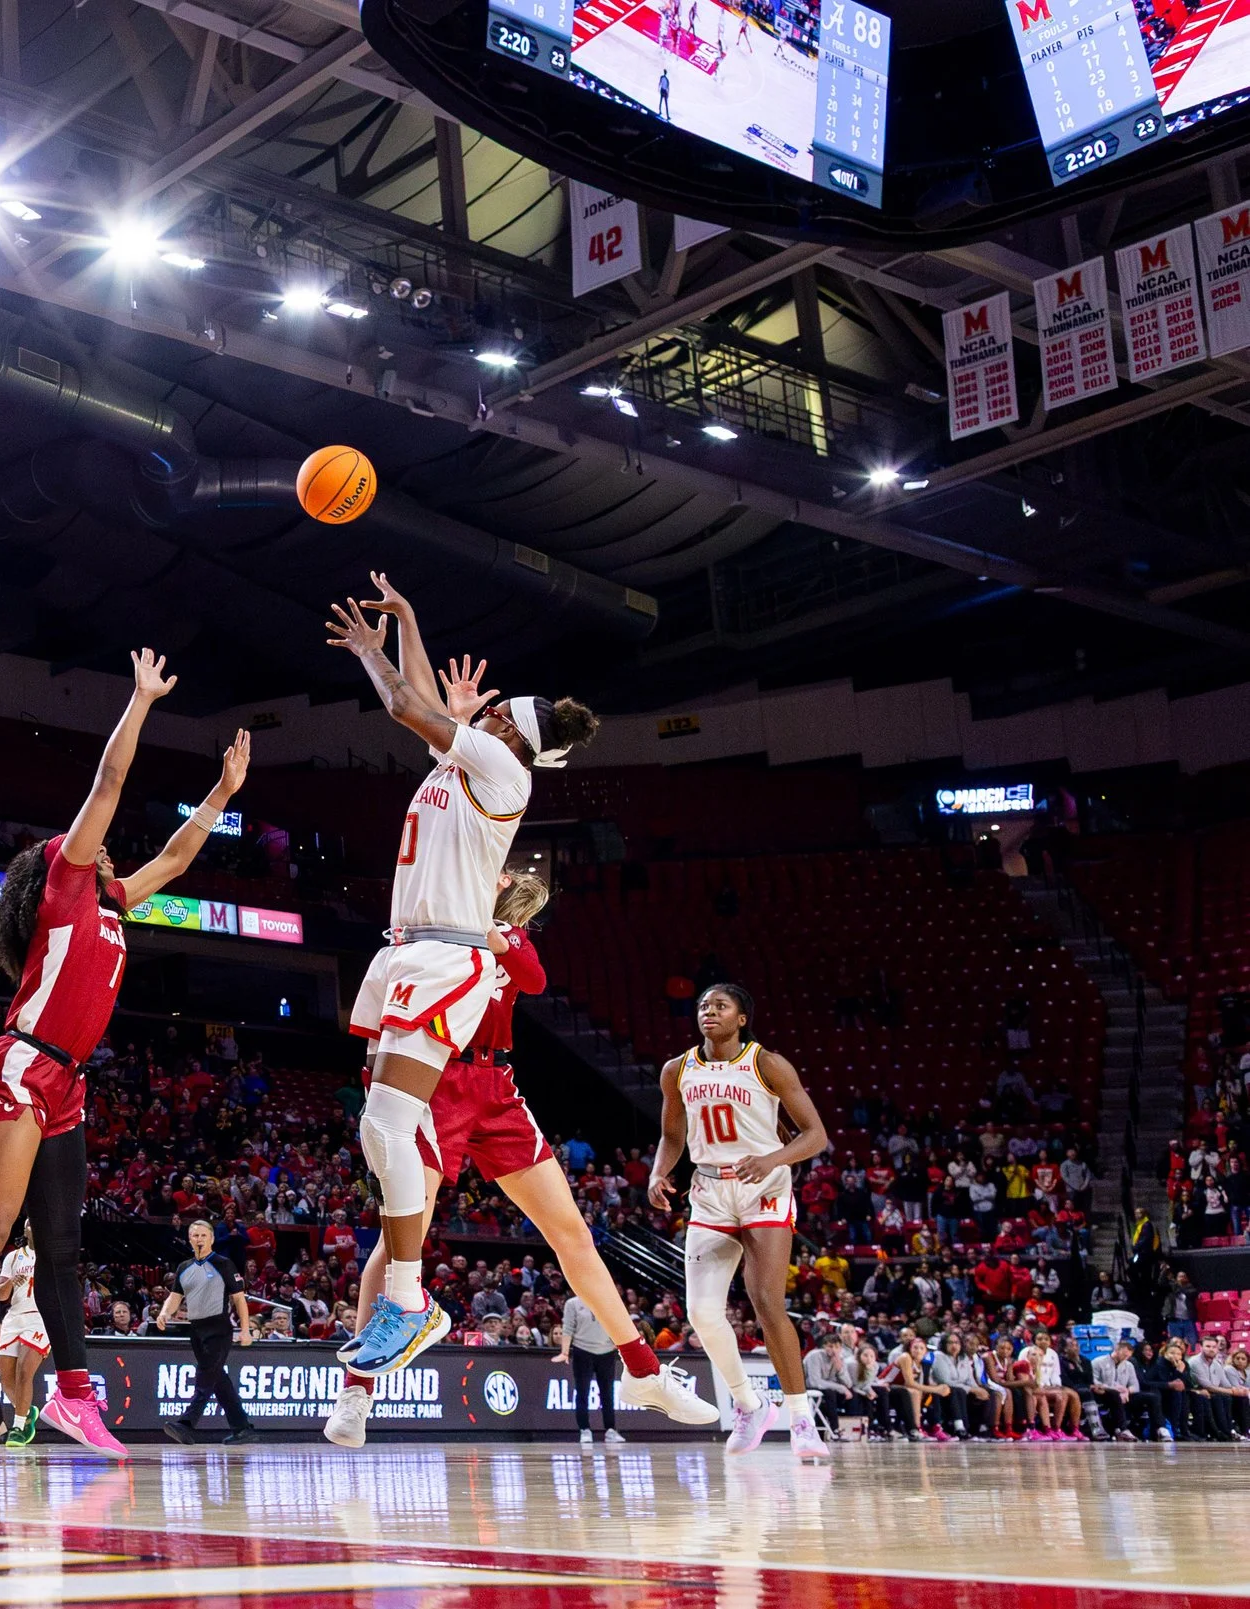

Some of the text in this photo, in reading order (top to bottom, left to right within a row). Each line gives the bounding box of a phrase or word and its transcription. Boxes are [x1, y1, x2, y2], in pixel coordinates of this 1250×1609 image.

[854, 10, 881, 49] 88
[1015, 0, 1053, 32] M
[1038, 14, 1080, 42] FOULS 5
[498, 26, 565, 68] 2:20 23
[1030, 11, 1121, 64] PLAYER PTS F
[1046, 25, 1127, 73] 0 21 4
[825, 51, 845, 68] PLAYER
[853, 64, 864, 77] PTS
[1051, 40, 1130, 87] 1 17 1
[1054, 55, 1135, 102] 2 23 4
[826, 98, 838, 112] 20
[852, 94, 863, 108] 34
[873, 103, 879, 115] 2
[874, 87, 880, 99] 2
[1055, 70, 1139, 118] 10 6 3
[826, 113, 837, 128] 21
[1058, 85, 1143, 133] 14 18 2
[825, 129, 836, 143] 22
[871, 148, 878, 160] 2
[1065, 118, 1156, 172] 2:20 23
[1220, 207, 1250, 246] M
[588, 225, 623, 266] 42
[1139, 238, 1171, 274] M
[1217, 244, 1250, 266] NCA
[1056, 271, 1085, 305] M
[1126, 278, 1192, 310] TOURNAMENT
[1136, 271, 1178, 294] NCAA
[963, 304, 990, 338] M
[1042, 308, 1105, 339] TOURNAMENT
[1052, 301, 1092, 323] NCAA
[950, 343, 1008, 370] TOURNAMENT
[959, 335, 997, 356] NCAA
[1135, 357, 1163, 374] 2017
[328, 477, 367, 519] Wilson
[164, 901, 189, 921] Starry
[210, 904, 299, 934] M TOYOTA
[109, 952, 124, 989] 1
[389, 982, 416, 1007] M
[686, 1084, 751, 1106] MARYLAND
[701, 1103, 738, 1144] 10
[759, 1196, 778, 1212] M
[33, 1331, 43, 1343] M
[238, 1365, 345, 1400] SECOND
[371, 1368, 440, 1401] OUND
[487, 1373, 517, 1411] SEC
[243, 1403, 300, 1417] UNIVERSITY
[375, 1404, 415, 1419] COLLEGE
[417, 1405, 443, 1418] PARK
